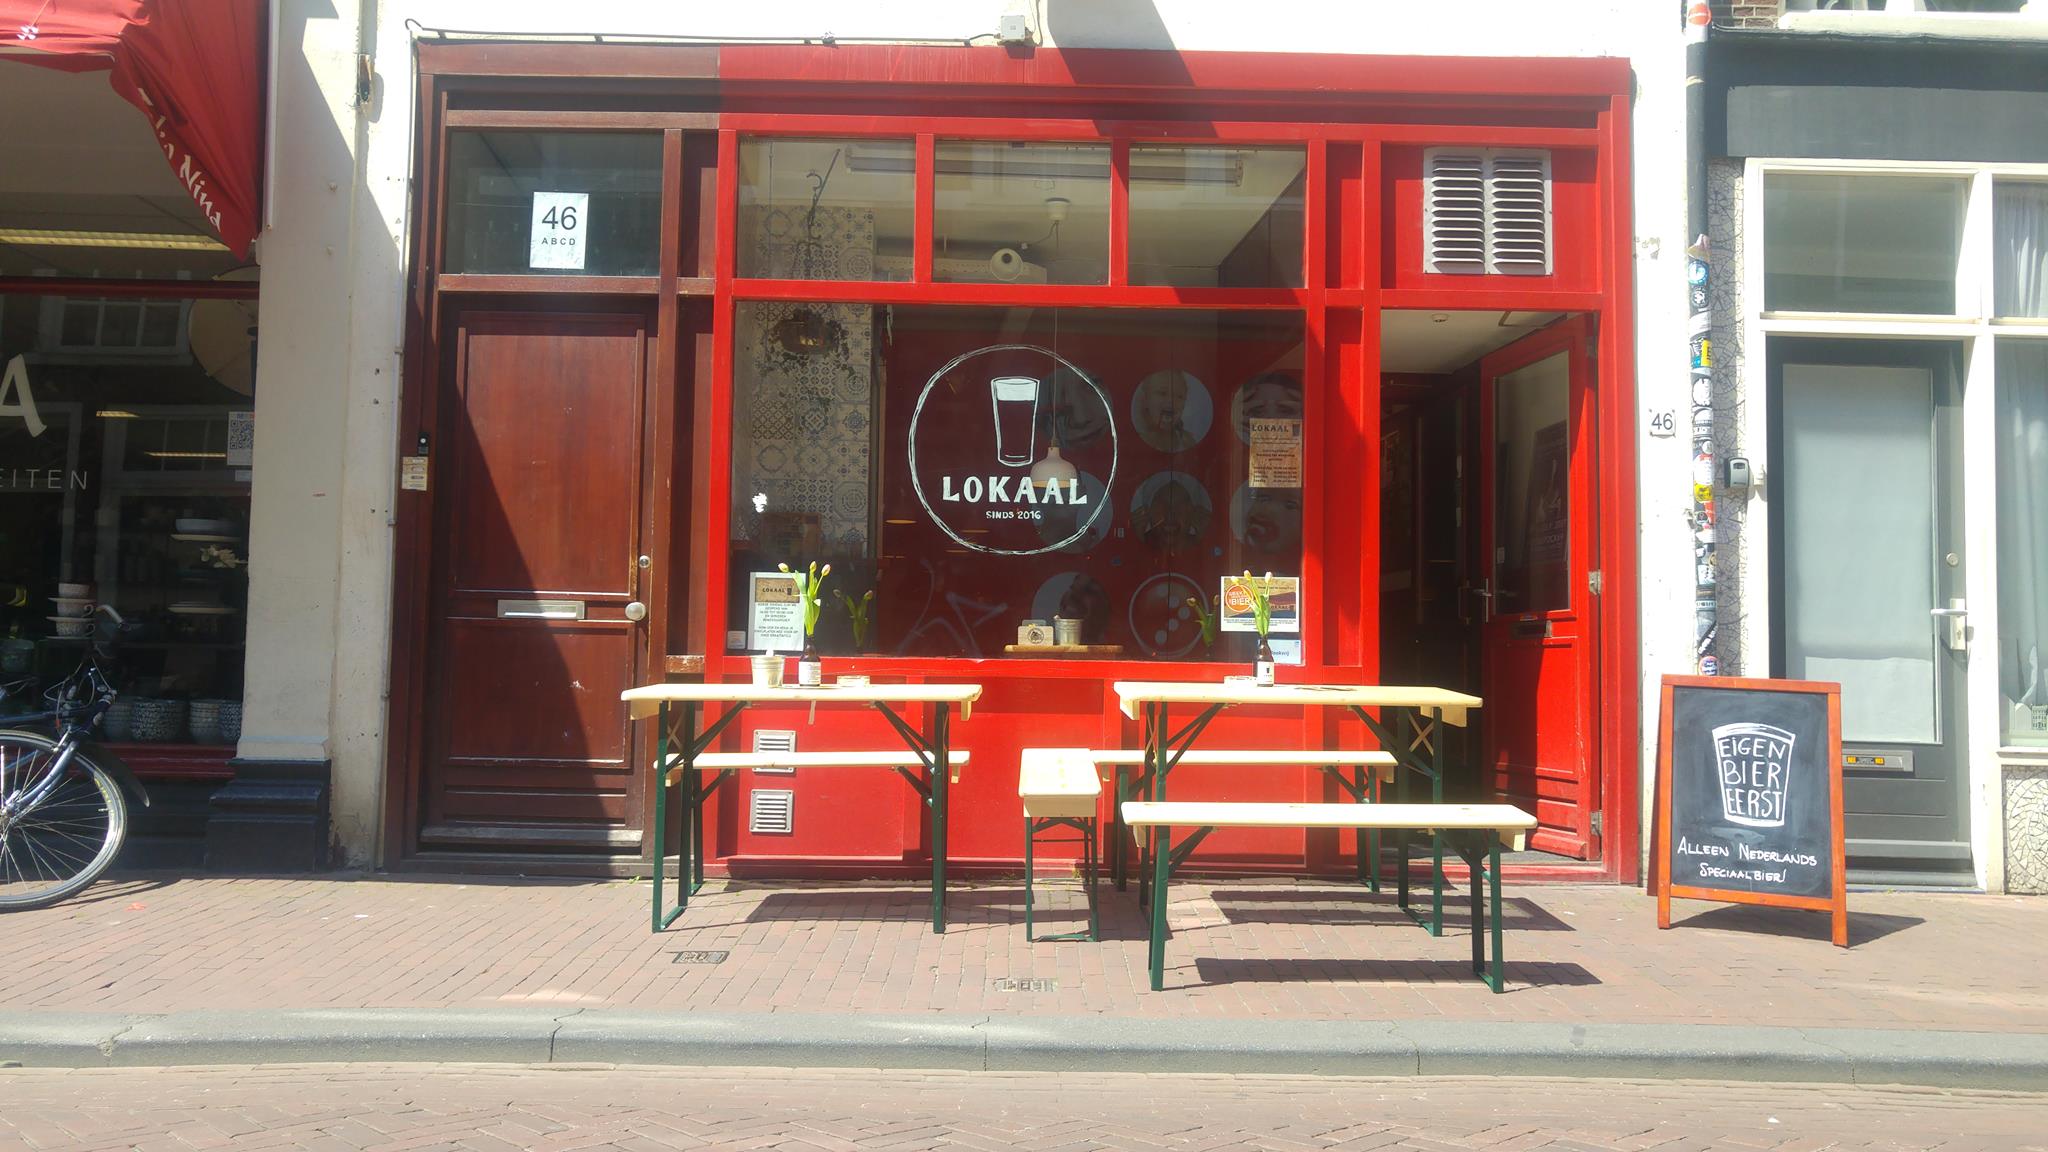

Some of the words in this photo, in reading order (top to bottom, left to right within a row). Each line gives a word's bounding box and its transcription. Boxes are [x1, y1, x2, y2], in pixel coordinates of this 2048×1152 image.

[180, 154, 221, 232] Nina
[541, 206, 577, 230] 46
[1252, 424, 1289, 432] LOKAAL
[1651, 413, 1673, 430] 46
[942, 476, 1087, 505] LOKAAL
[985, 511, 1015, 519] SINDS
[1017, 511, 1042, 519] 2016
[1723, 760, 1782, 789] BIER
[1726, 788, 1782, 819] EERST
[1677, 836, 1729, 857] ALLEEN
[1739, 843, 1817, 866] NEDERLANDS
